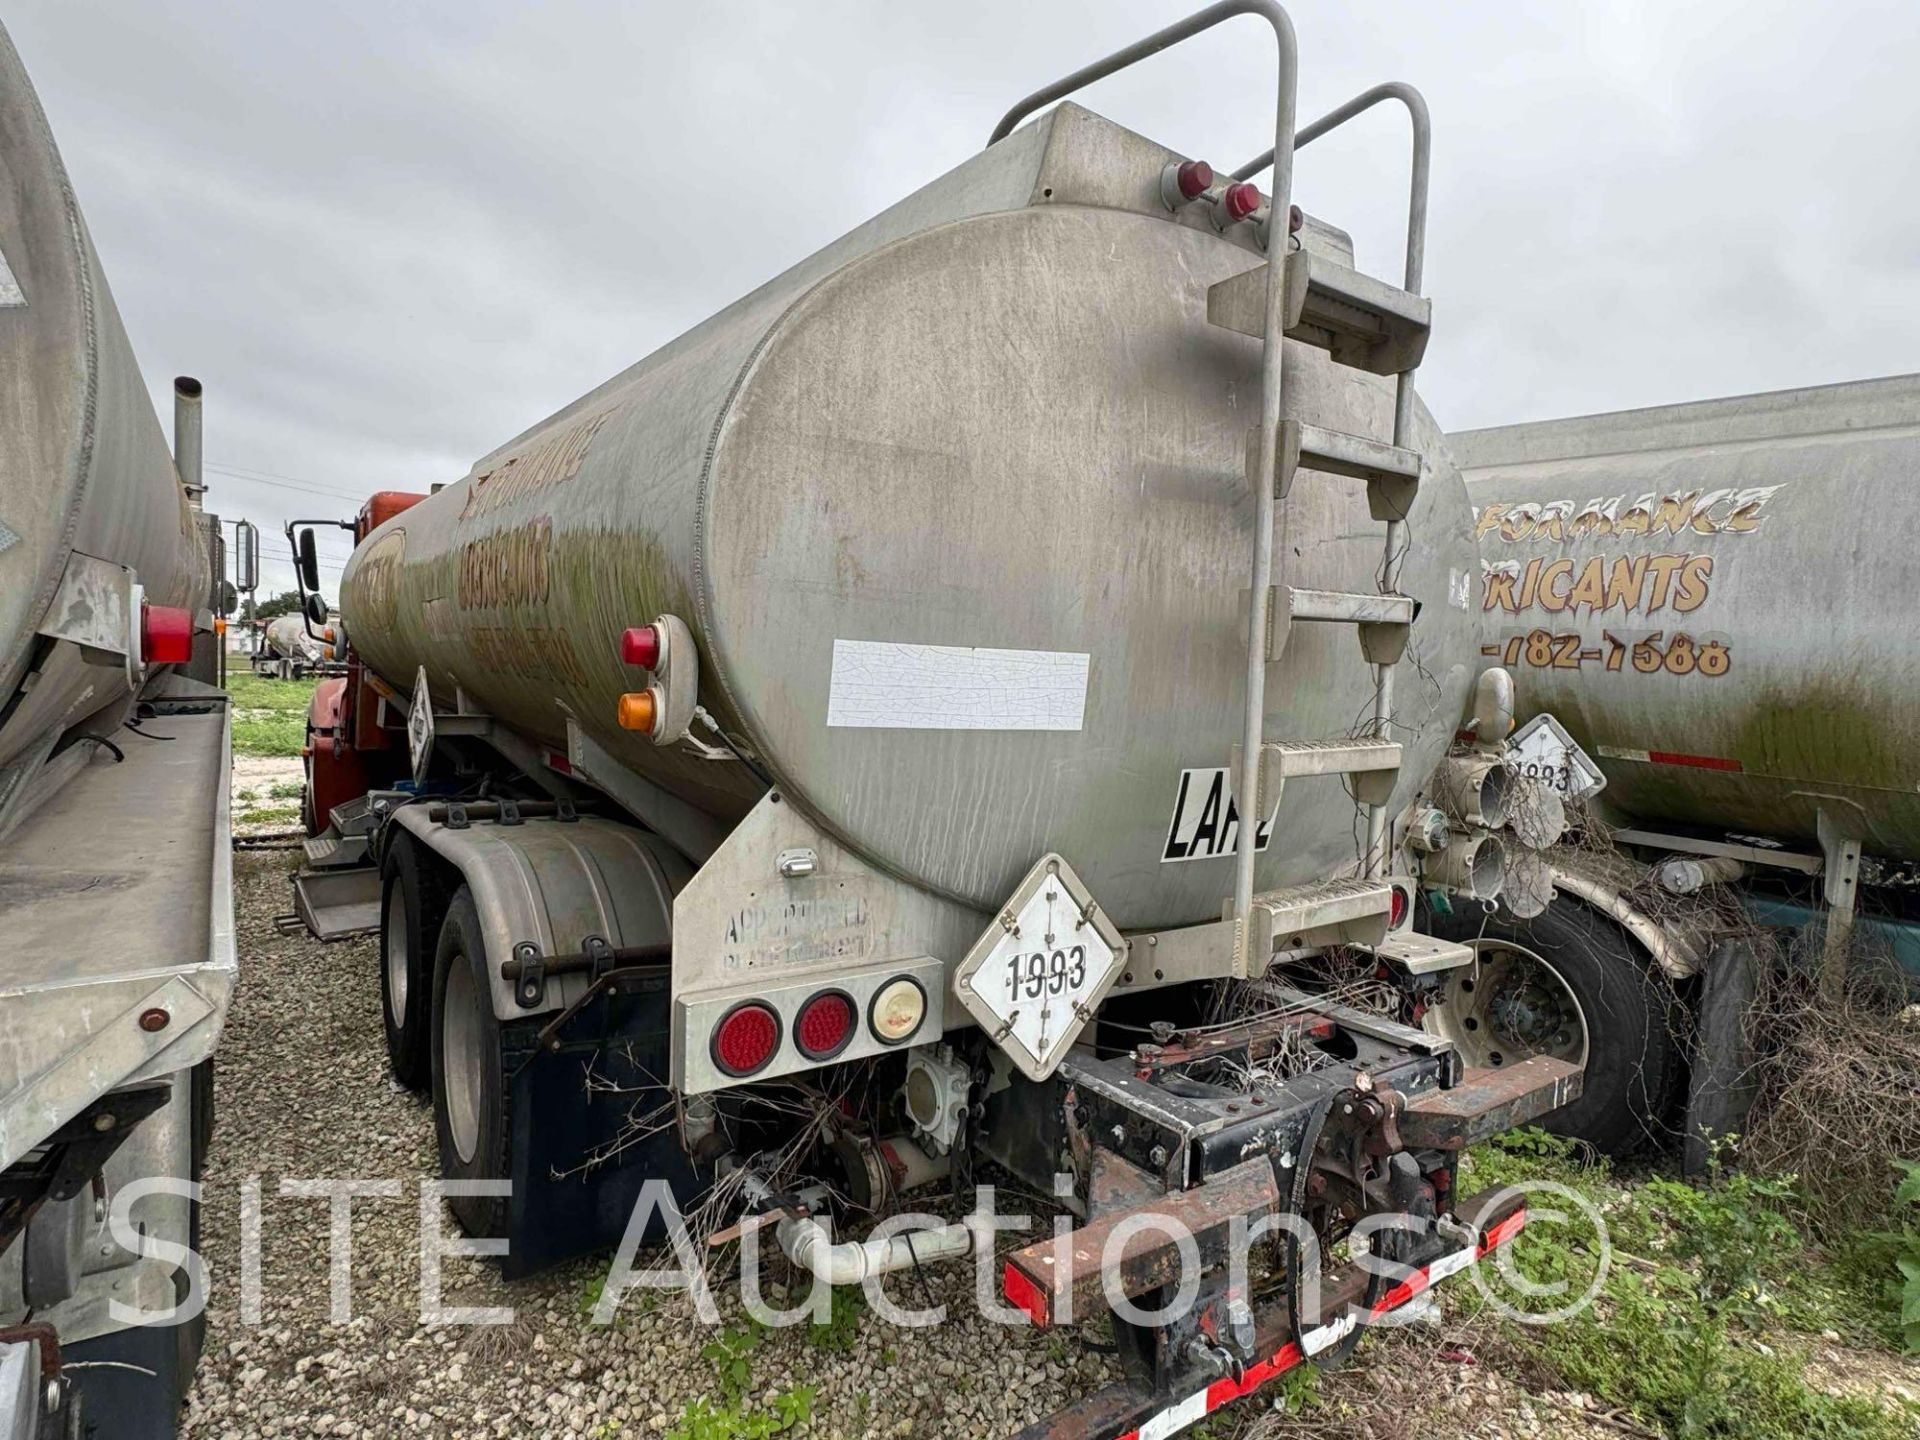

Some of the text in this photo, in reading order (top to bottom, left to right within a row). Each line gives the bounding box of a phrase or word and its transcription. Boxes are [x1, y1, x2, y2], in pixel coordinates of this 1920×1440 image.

[1473, 484, 1787, 543] FORMANCE
[1480, 552, 1717, 616] RICANTS
[1008, 945, 1087, 1002] 1993
